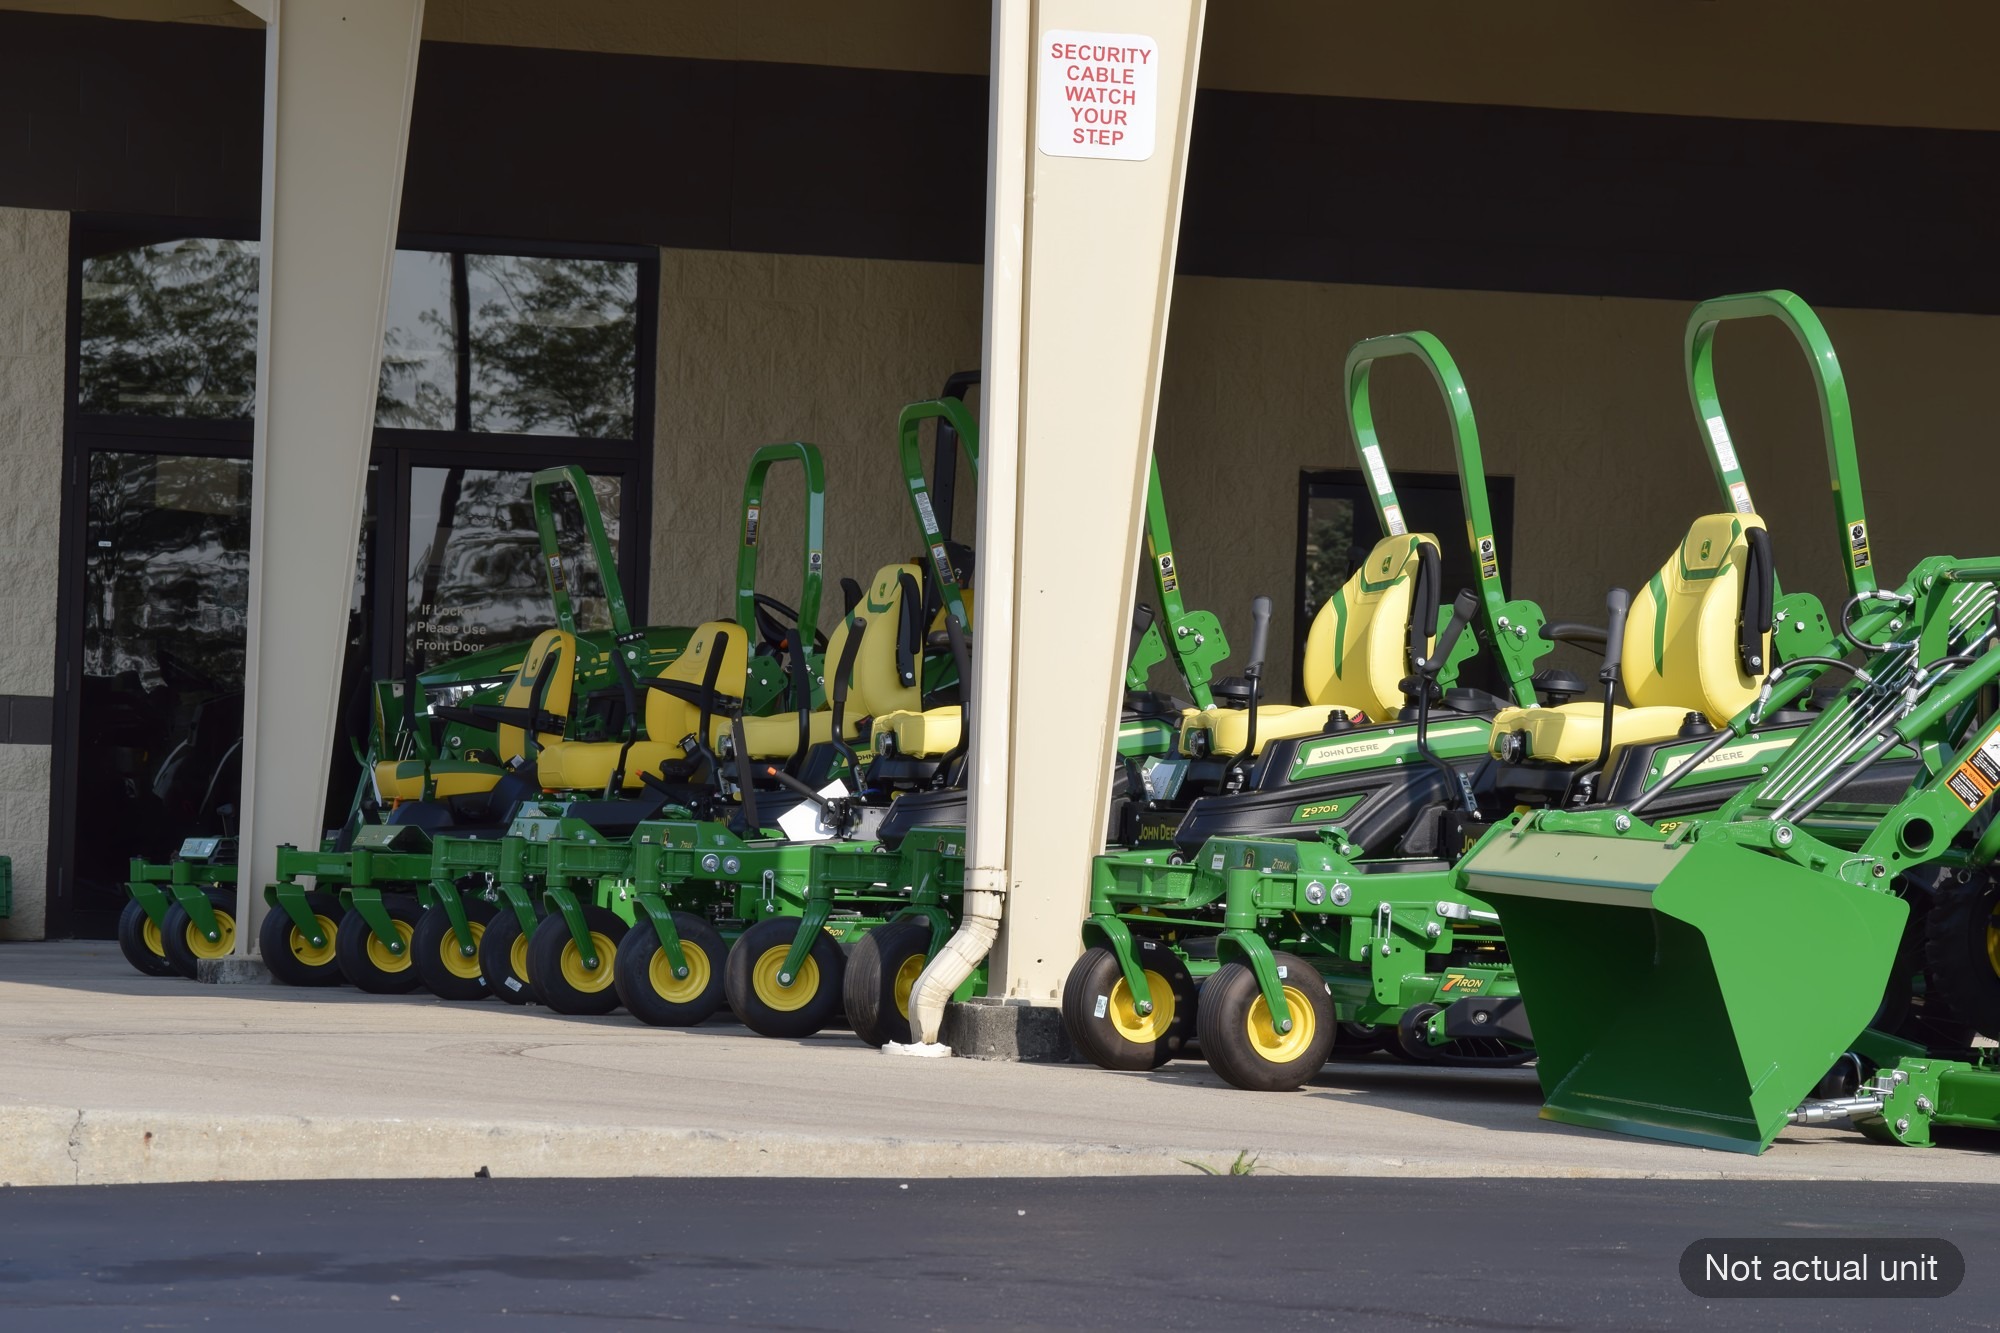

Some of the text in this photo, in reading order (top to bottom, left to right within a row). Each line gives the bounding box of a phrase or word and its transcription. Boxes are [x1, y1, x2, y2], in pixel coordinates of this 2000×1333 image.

[1051, 43, 1151, 64] SECURITY
[1066, 65, 1134, 84] CABLE
[1065, 86, 1136, 105] WATCH
[1070, 107, 1127, 125] YOUR
[1073, 128, 1124, 145] STEP
[421, 604, 431, 615] If
[417, 622, 487, 635] Please Use
[416, 639, 485, 652] Front Door
[857, 753, 876, 761] OHN
[1318, 743, 1379, 759] JOHN DEERE
[1707, 750, 1744, 763] DEERE
[1301, 804, 1339, 818] Z970R
[1139, 823, 1178, 840] JOHN DEE
